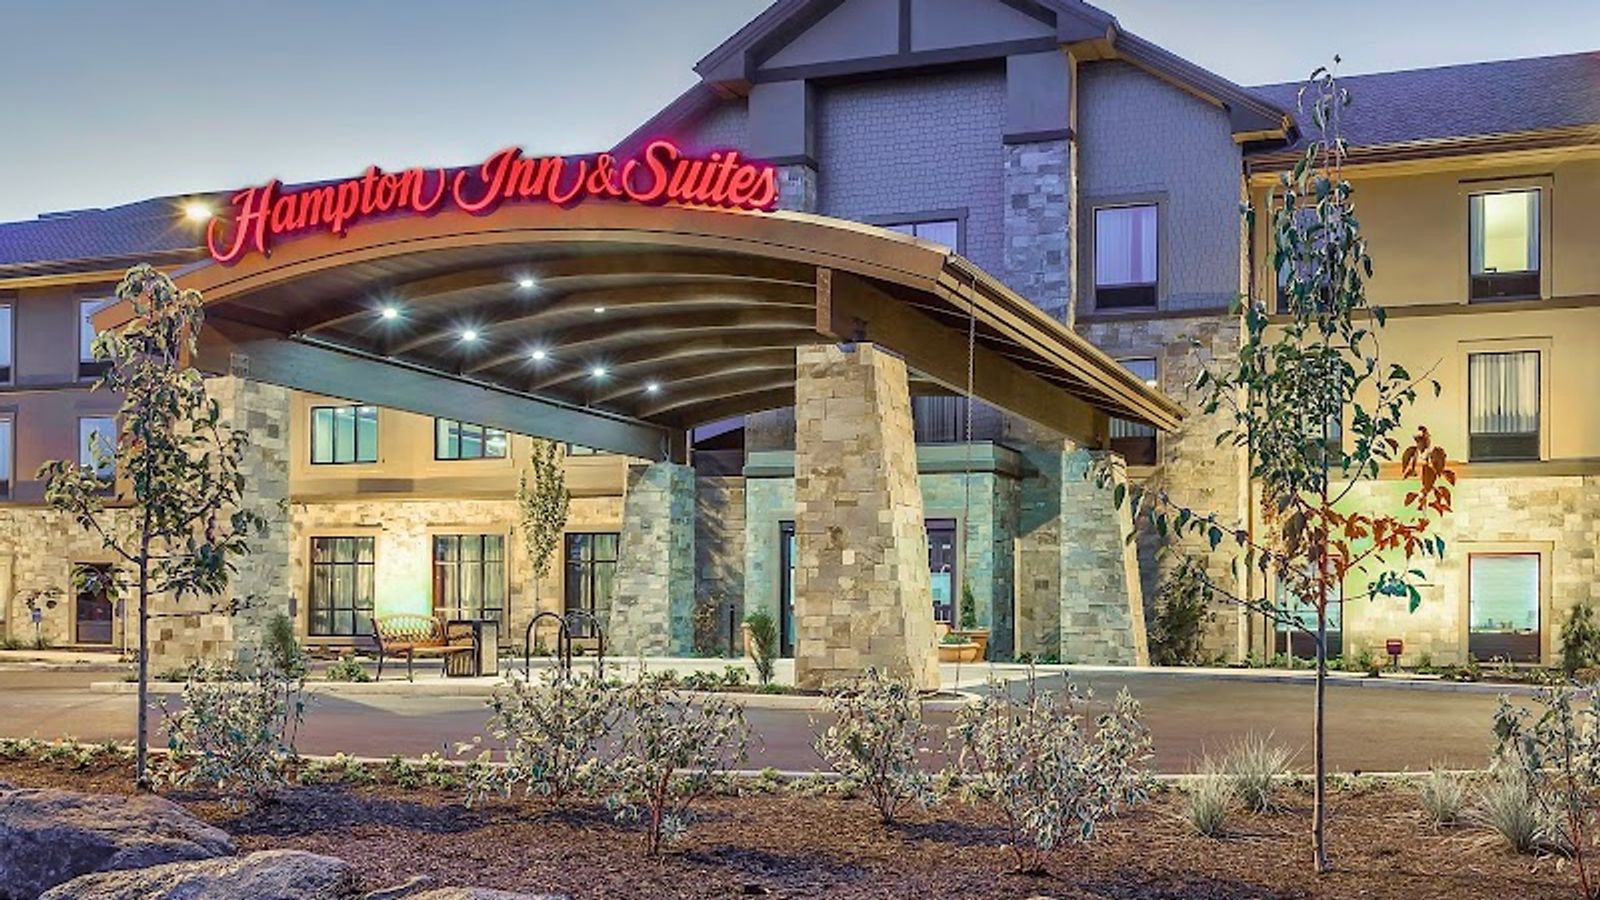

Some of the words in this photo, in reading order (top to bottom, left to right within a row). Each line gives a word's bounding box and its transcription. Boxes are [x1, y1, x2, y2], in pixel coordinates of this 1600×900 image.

[207, 165, 446, 262] Hampton
[453, 146, 586, 211] Inn
[586, 153, 623, 196] &
[622, 140, 777, 207] Suites
